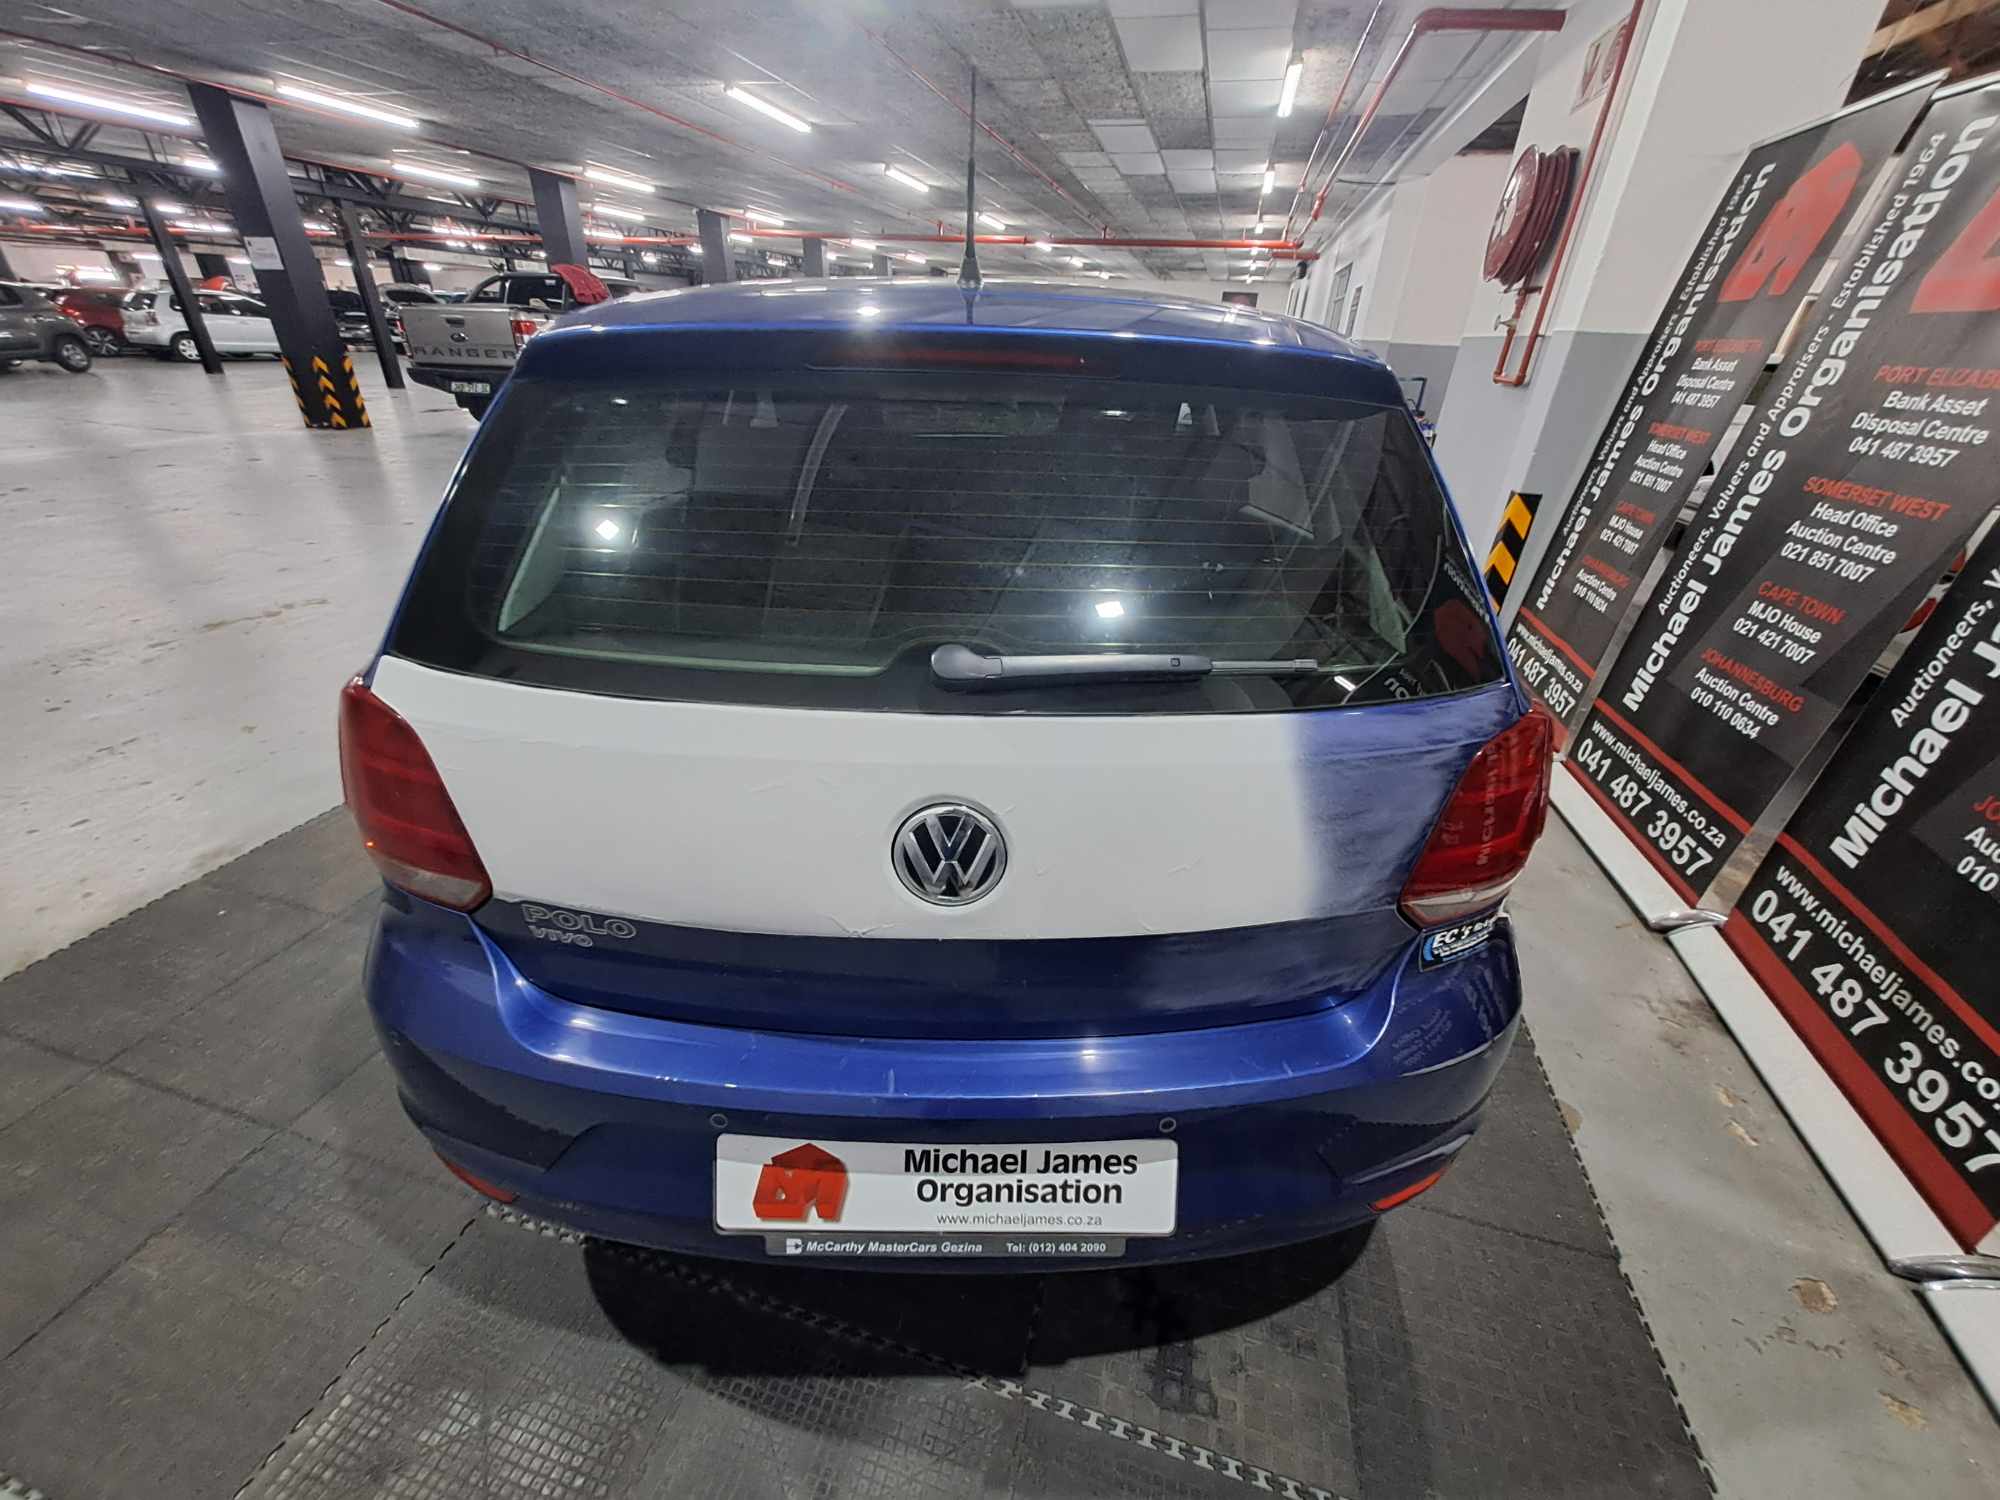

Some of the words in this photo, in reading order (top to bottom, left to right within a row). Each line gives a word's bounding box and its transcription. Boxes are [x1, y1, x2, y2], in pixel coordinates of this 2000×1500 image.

[1680, 216, 1728, 301] Established
[414, 346, 516, 359] RANGER
[1658, 525, 1715, 616] Auctioneers,
[1708, 459, 1750, 520] Valuers
[1746, 422, 1771, 457] and
[1768, 325, 1830, 422] Appraisers
[1831, 194, 1909, 309] Established
[1902, 131, 1948, 189] 1964
[1874, 363, 1929, 384] PORT
[1536, 506, 1592, 611] Michael
[1591, 404, 1644, 502] James
[1641, 162, 1777, 397] Organisation
[1883, 390, 1931, 411] Bank
[1928, 394, 1989, 416] Asset
[1622, 579, 1708, 712] Michael
[1702, 449, 1786, 576] James
[1779, 114, 2000, 437] Organisation
[1851, 411, 1927, 436] Disposal
[1923, 419, 1990, 444] Centre
[1848, 436, 1882, 455] 041
[1880, 441, 1914, 460] 487
[1908, 445, 1960, 467] 3957
[1803, 475, 1895, 508] SOMERSET
[1890, 495, 1951, 520] WEST
[1785, 520, 1843, 549] Auction
[1843, 536, 1896, 564] Centre
[1810, 502, 1855, 525] Head
[1851, 512, 1898, 538] Office
[1780, 542, 1810, 562] 021
[1808, 550, 1837, 571] 851
[1833, 558, 1875, 583] 7007
[1747, 600, 1781, 624] MJO
[1778, 614, 1822, 644] House
[1759, 581, 1800, 607] CAPE
[1799, 595, 1847, 625] TOWN
[1733, 617, 1760, 638] 021
[1757, 629, 1784, 650] 421
[1779, 639, 1816, 665] 7007
[1507, 637, 1527, 668] 041
[1523, 657, 1548, 687] 487
[1544, 677, 1577, 718] 3957
[1701, 648, 1805, 712] JOHANNESBURG
[1890, 600, 1994, 728] Auctioneers,
[1690, 686, 1713, 707] 010
[1712, 699, 1733, 720] 110
[1730, 710, 1761, 739] 0634
[1694, 667, 1740, 701] Auction
[1738, 693, 1780, 726] Centre
[1591, 720, 1727, 849] www.michaeljames.co.za
[1829, 678, 1984, 869] Michael
[1577, 738, 1612, 781] 041
[1609, 774, 1652, 817] 487
[1648, 810, 1713, 876] 3957
[1957, 856, 2000, 892] 010
[521, 903, 637, 939] POLO
[1751, 889, 1813, 961] 041
[1811, 963, 1890, 1036] 487
[904, 1149, 1027, 1174] Michael
[1036, 1150, 1138, 1174] James
[916, 1178, 1122, 1207] Organisation
[937, 1213, 1103, 1227] www.michaeljames.co.za
[807, 1240, 868, 1254] McCarthy
[867, 1242, 937, 1254] MasterCars
[941, 1242, 982, 1253] Gezina
[1006, 1242, 1026, 1253] Tel:
[1028, 1242, 1056, 1254] (012)
[1058, 1242, 1078, 1252] 404
[1080, 1242, 1106, 1253] 2090
